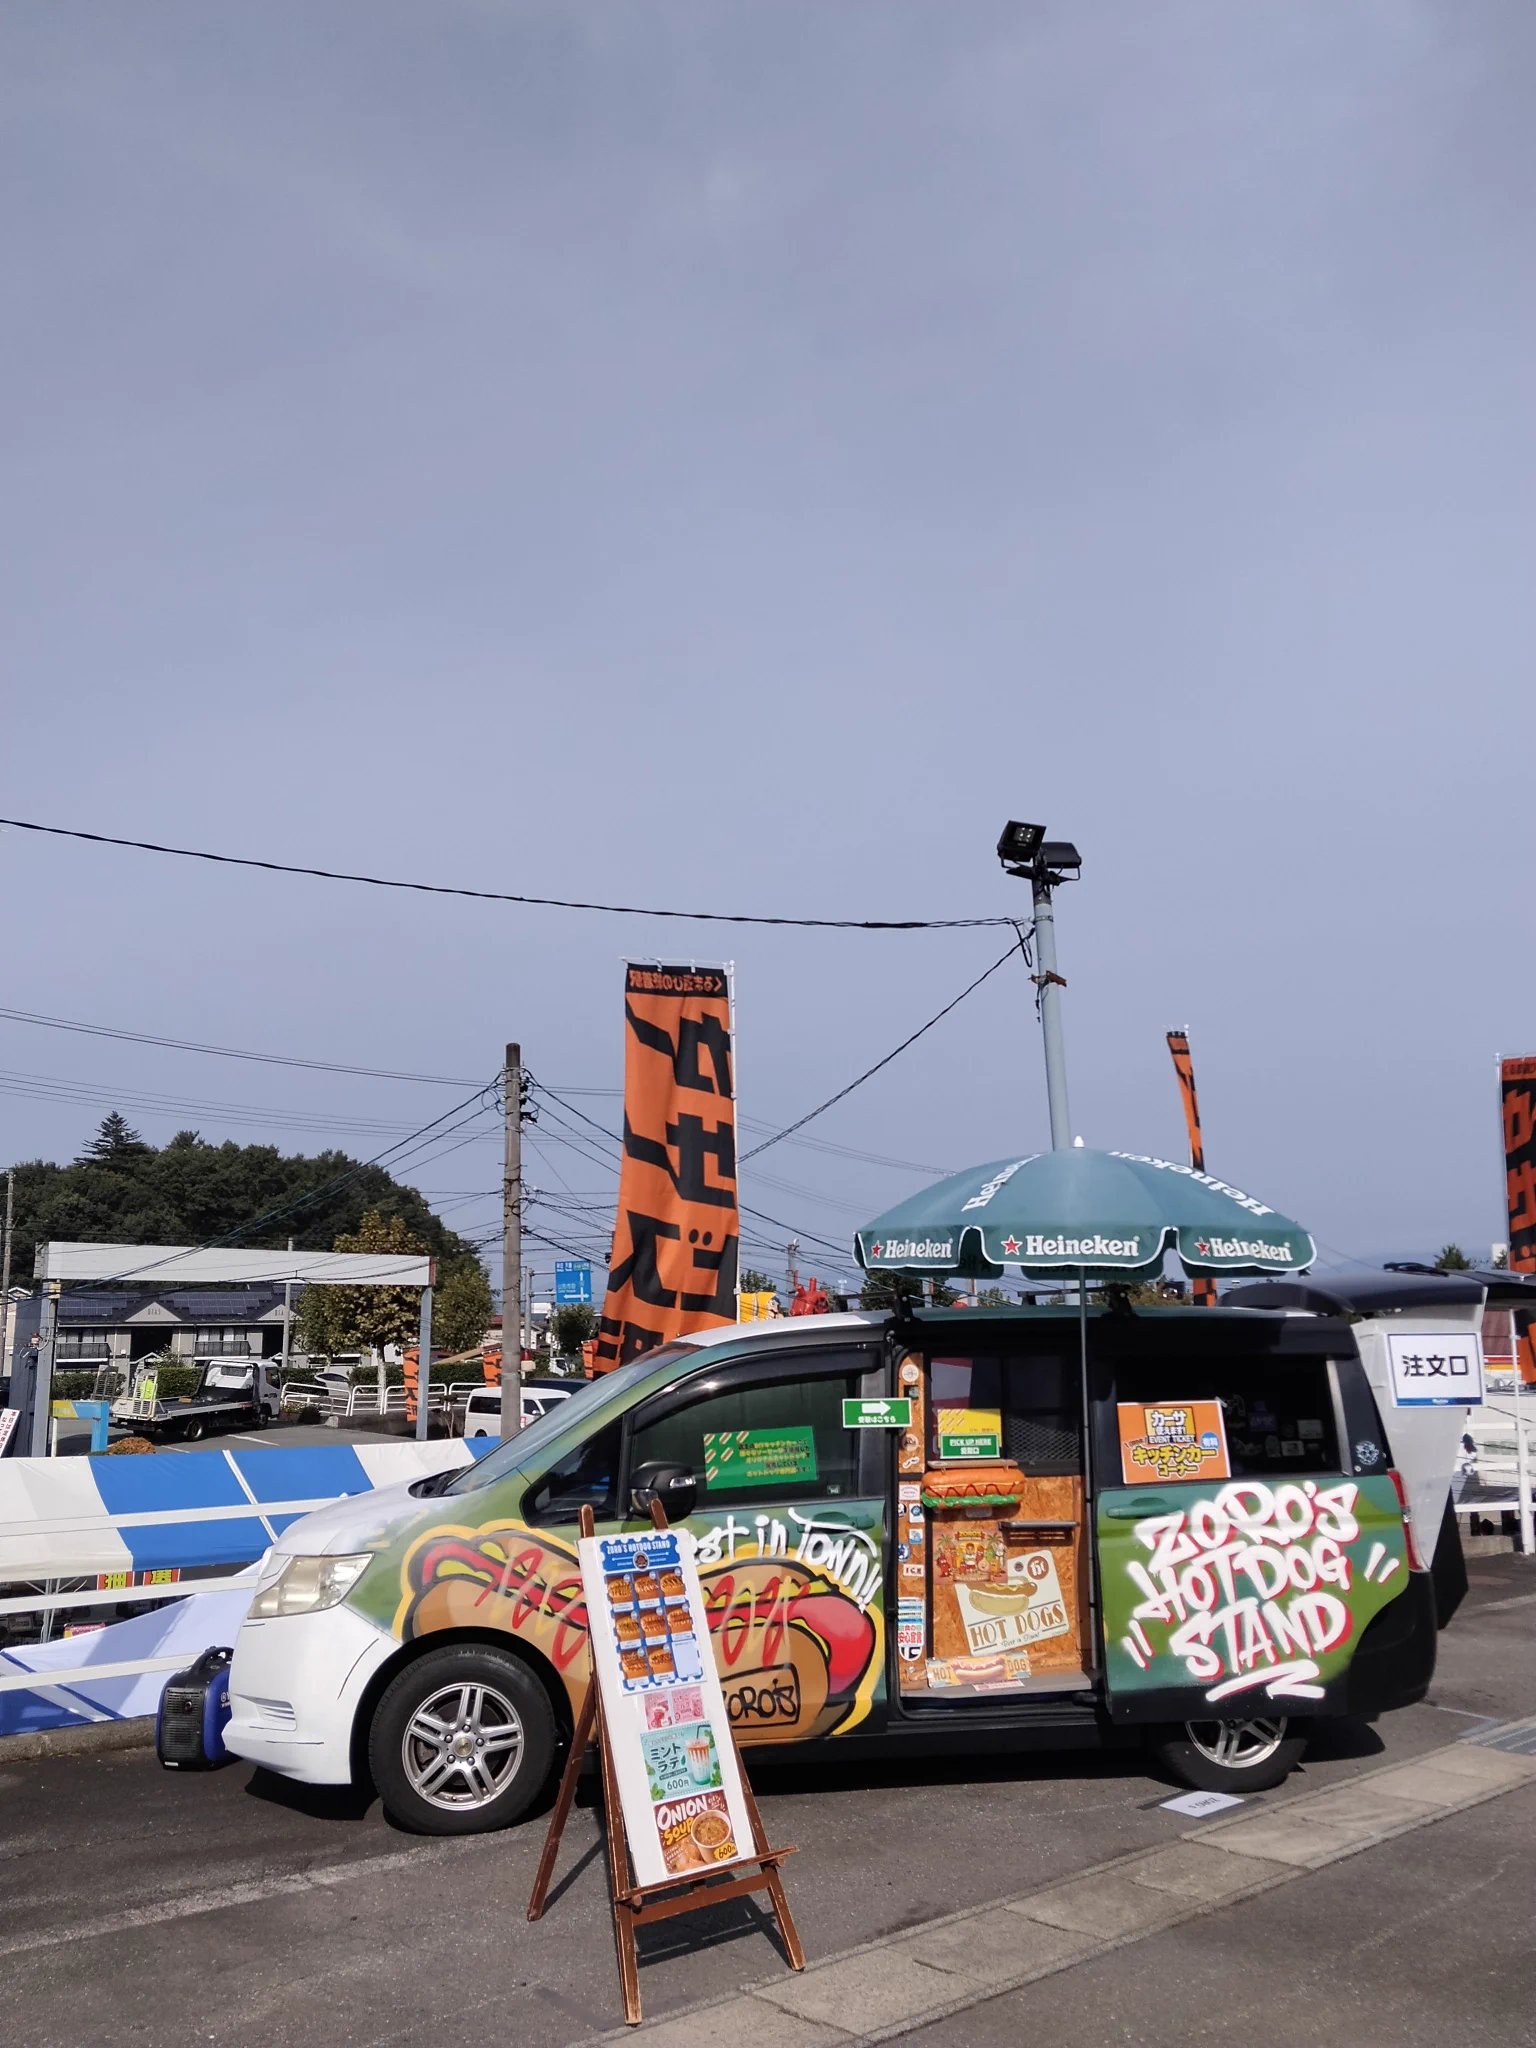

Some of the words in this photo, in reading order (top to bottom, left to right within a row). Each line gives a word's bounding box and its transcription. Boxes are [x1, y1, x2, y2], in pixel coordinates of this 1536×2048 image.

[884, 1238, 953, 1259] Heineken
[1025, 1235, 1140, 1256] Heineken
[1209, 1237, 1293, 1261] Heineken
[1401, 1354, 1469, 1377] 注文口
[858, 1415, 896, 1424] 受取はこちら
[1151, 1410, 1187, 1427] カーサ
[950, 1438, 964, 1446] PICK
[965, 1438, 975, 1446] UP
[975, 1438, 992, 1446] HERE
[1149, 1436, 1170, 1444] EVENT
[1172, 1435, 1195, 1443] TICKET
[1133, 1444, 1216, 1465] キッチンカー
[1158, 1463, 1198, 1476] コーナー
[755, 1514, 788, 1556] in
[1134, 1480, 1359, 1578] ZORO'S
[606, 1544, 628, 1555] ZORO'S
[652, 1540, 671, 1550] STAND
[969, 1619, 1007, 1649] HOT
[1014, 1603, 1065, 1635] DOGS
[1169, 1592, 1351, 1678] STAND
[1007, 1659, 1028, 1673] DOG
[722, 1679, 797, 1723] ORO'S
[650, 1742, 682, 1762] ミント
[657, 1756, 681, 1774] ラテ
[666, 1777, 690, 1791] 600円
[657, 1795, 709, 1831] ONION
[664, 1817, 695, 1846] SOUP
